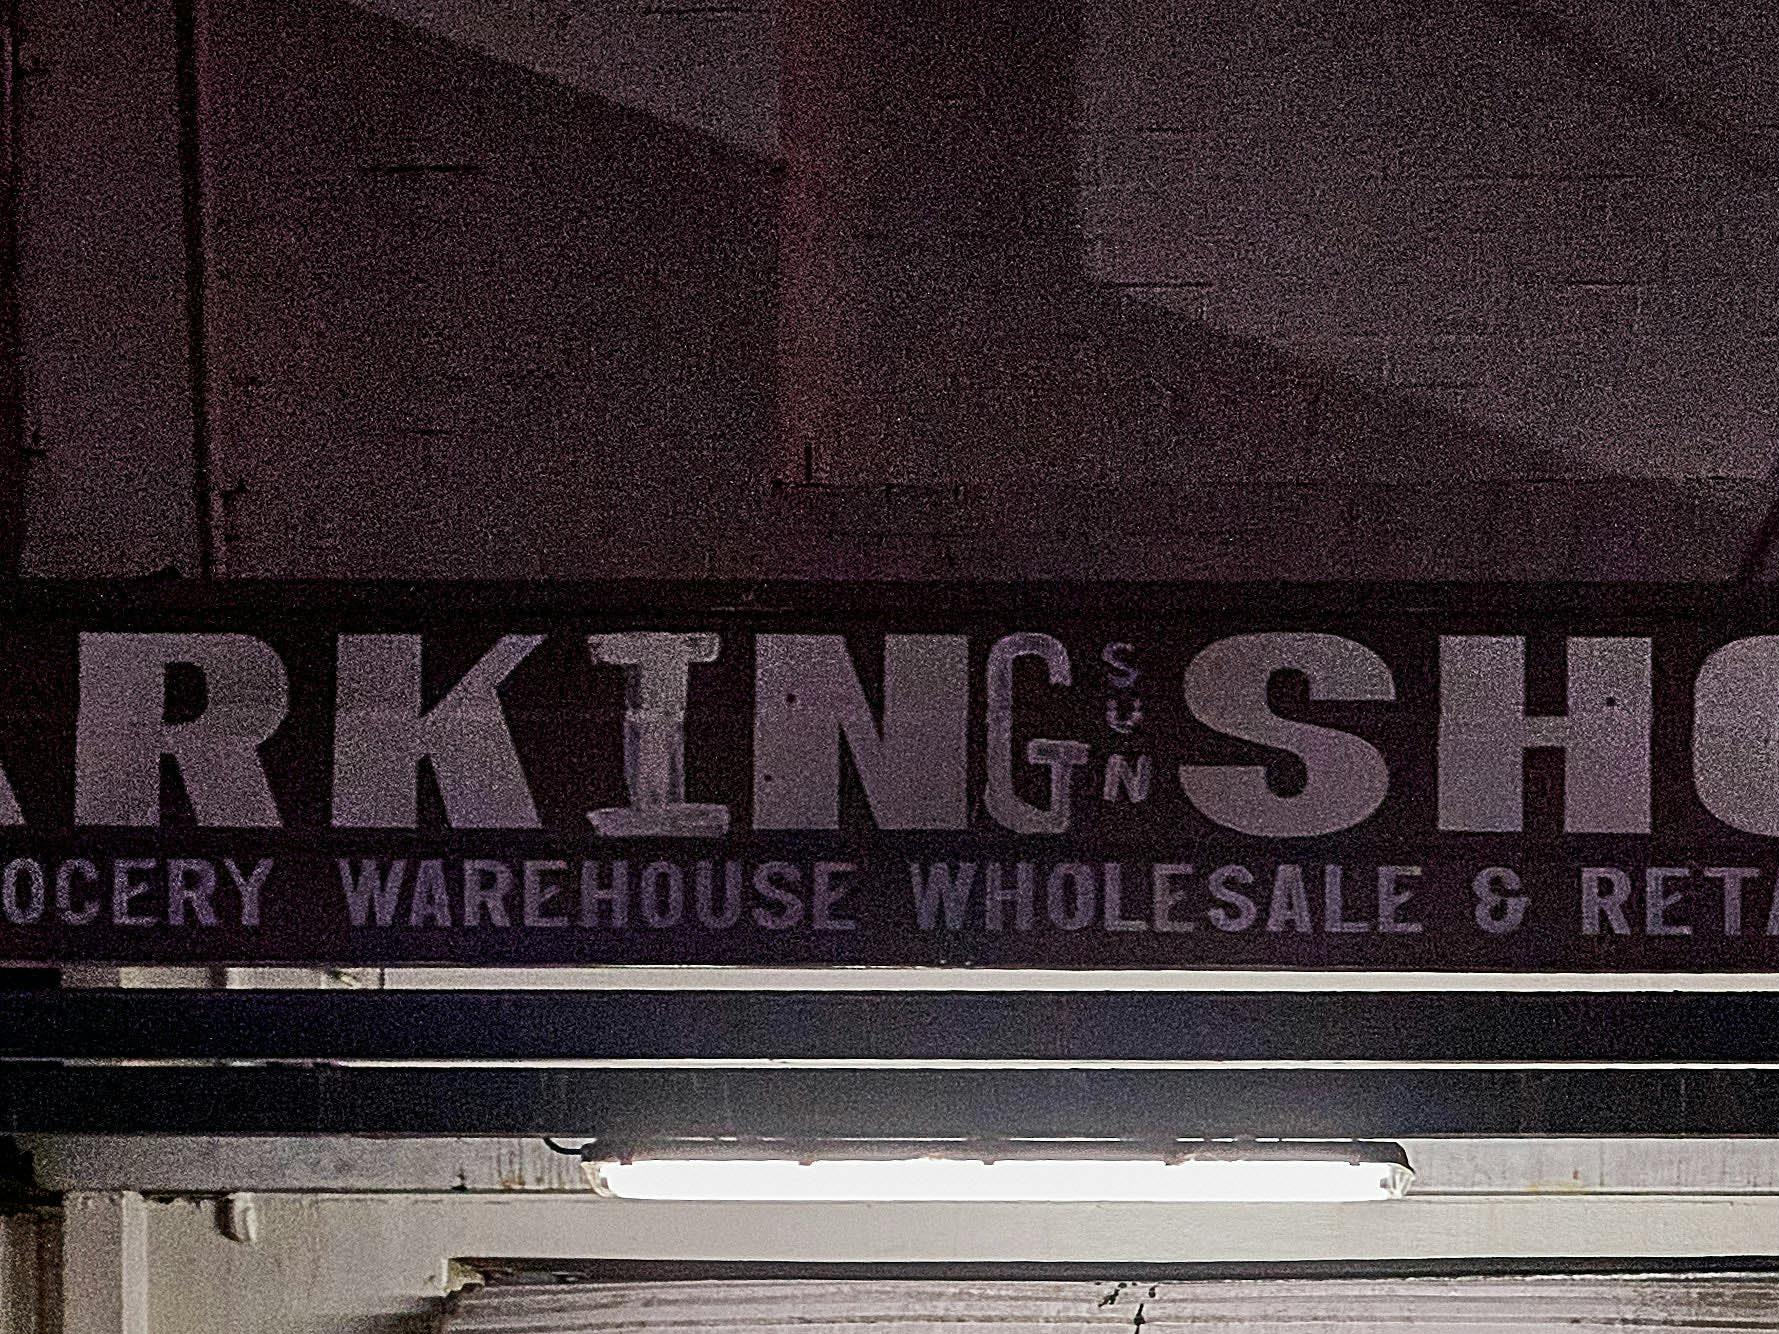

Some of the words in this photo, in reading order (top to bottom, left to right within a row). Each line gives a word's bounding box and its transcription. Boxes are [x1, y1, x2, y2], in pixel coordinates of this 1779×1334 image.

[0, 631, 1090, 836] RKING
[337, 858, 857, 931] WAREHOUSE
[911, 859, 1423, 934] WHOLESALE
[1473, 864, 1530, 935] &
